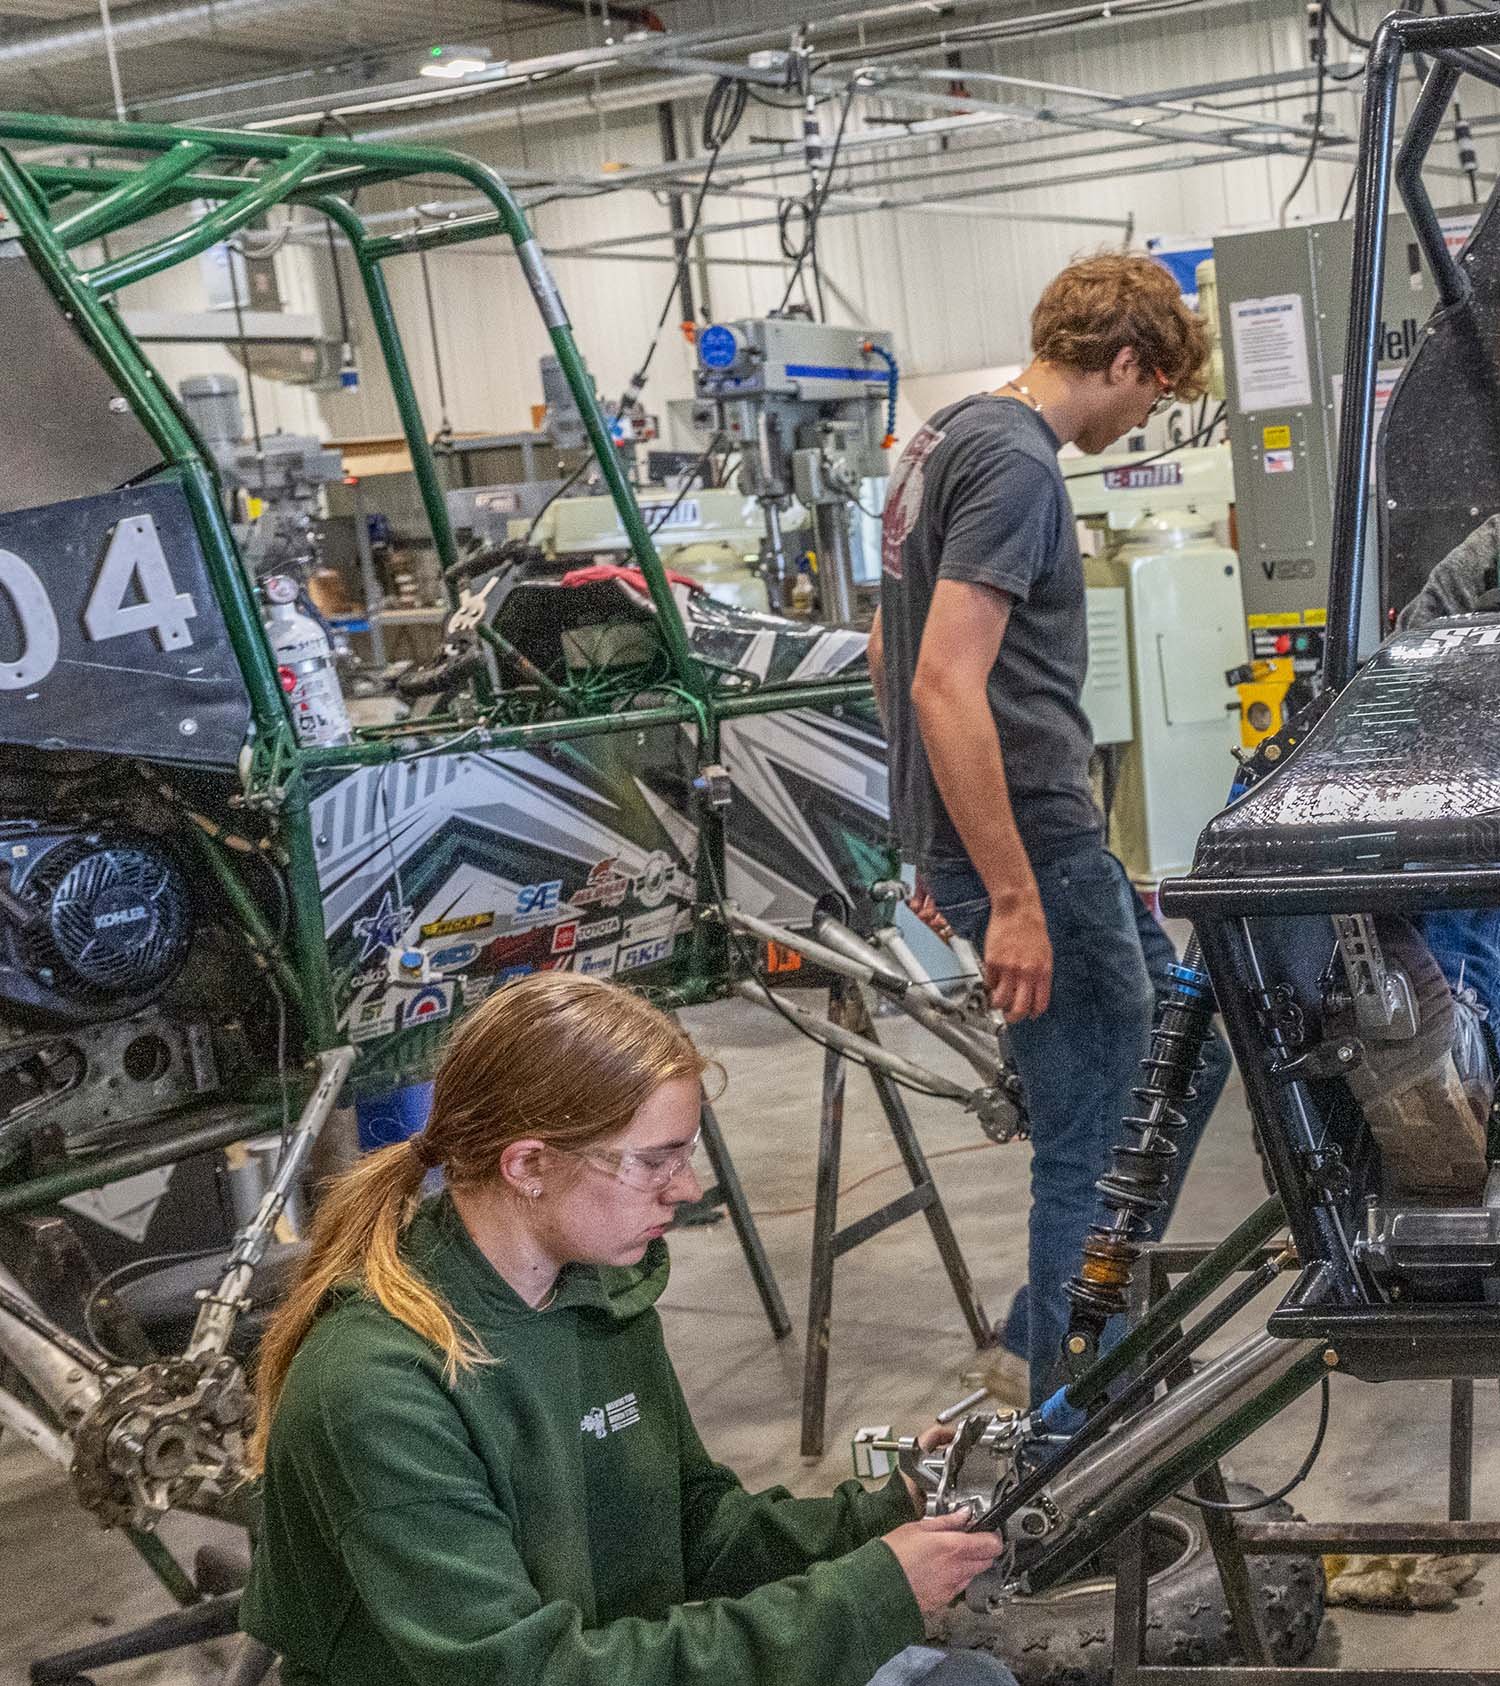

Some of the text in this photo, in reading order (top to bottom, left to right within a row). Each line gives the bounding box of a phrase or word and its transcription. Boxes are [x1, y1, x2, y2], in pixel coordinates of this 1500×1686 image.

[515, 880, 562, 914] SAE
[94, 906, 148, 929] KOHLER
[578, 918, 618, 939] TOYOTA
[624, 942, 670, 967] SKF
